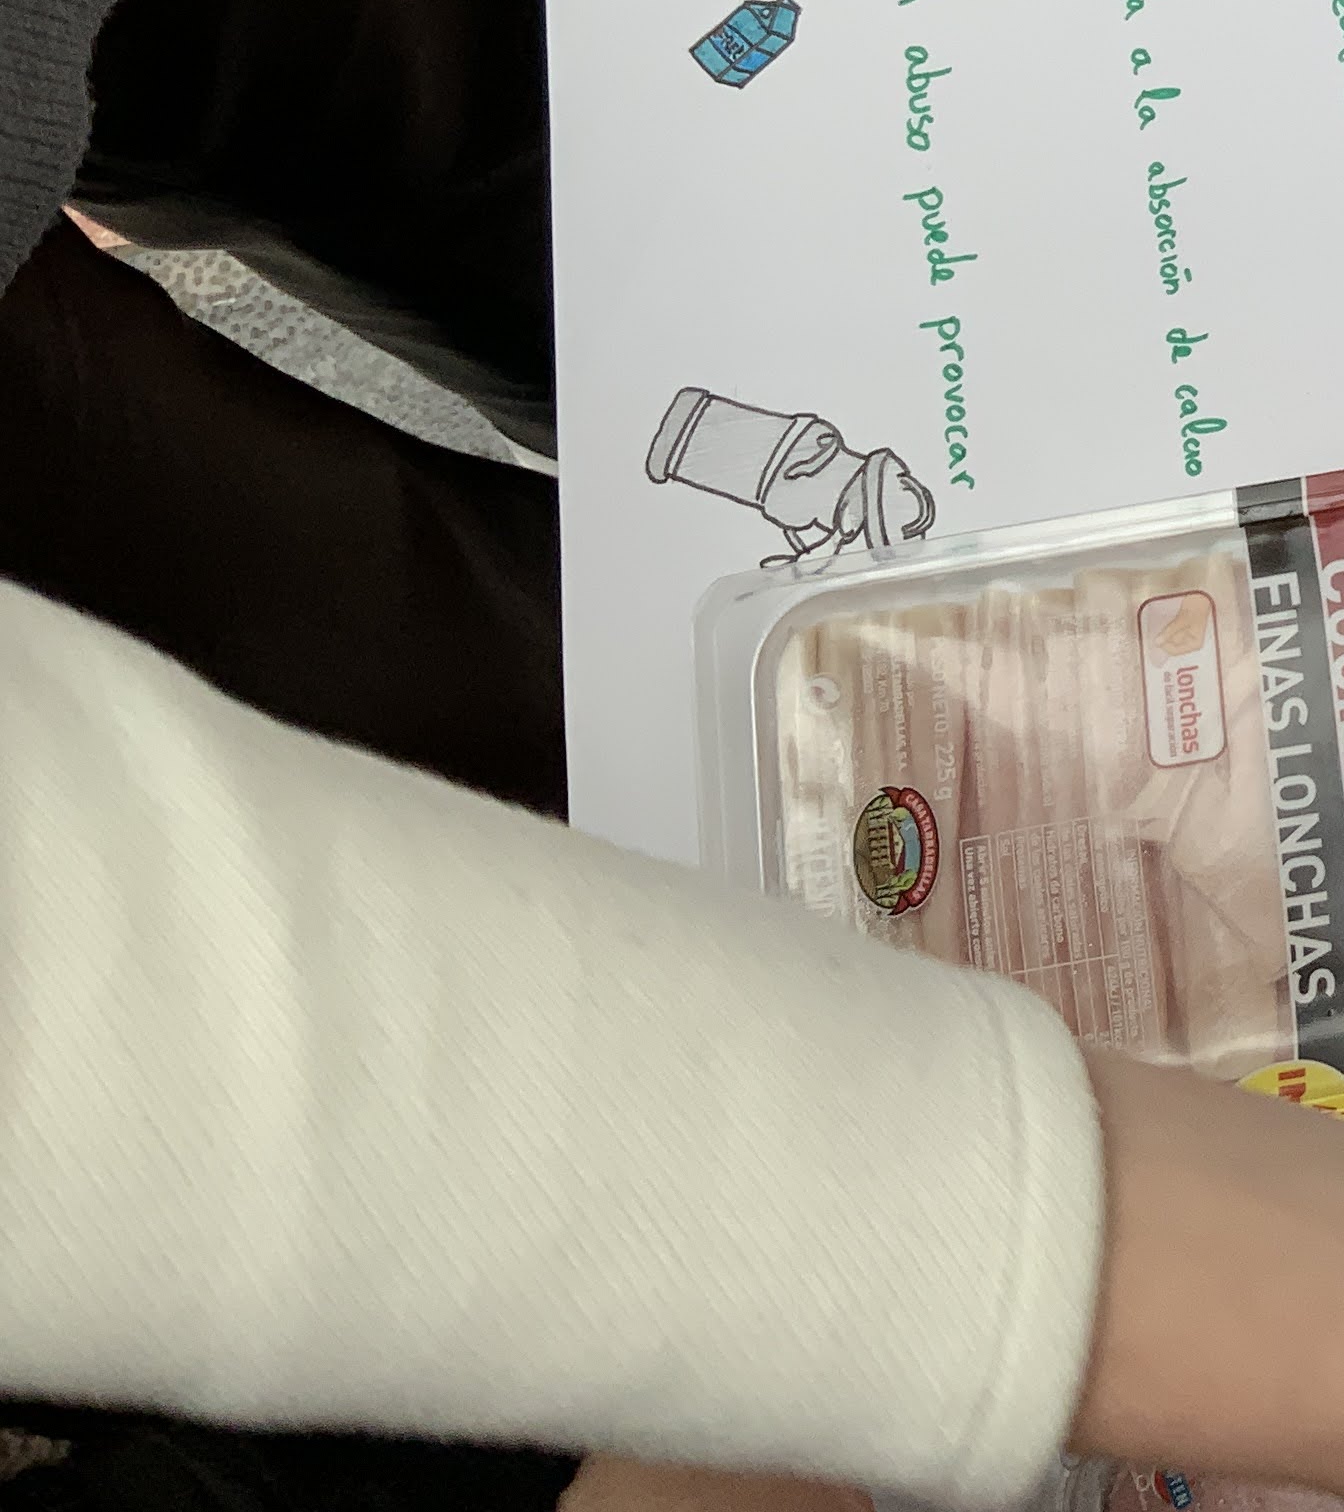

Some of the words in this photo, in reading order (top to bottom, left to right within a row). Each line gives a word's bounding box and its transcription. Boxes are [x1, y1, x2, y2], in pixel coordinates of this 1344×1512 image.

[903, 45, 952, 152] abuso
[1129, 47, 1153, 73] a
[1134, 86, 1182, 127] la
[902, 186, 977, 285] puede
[1165, 327, 1208, 363] de
[918, 315, 975, 488] provocar
[1250, 571, 1309, 734] FINAS
[1177, 665, 1202, 755] lonchas
[1270, 744, 1337, 1006] LONCHAS
